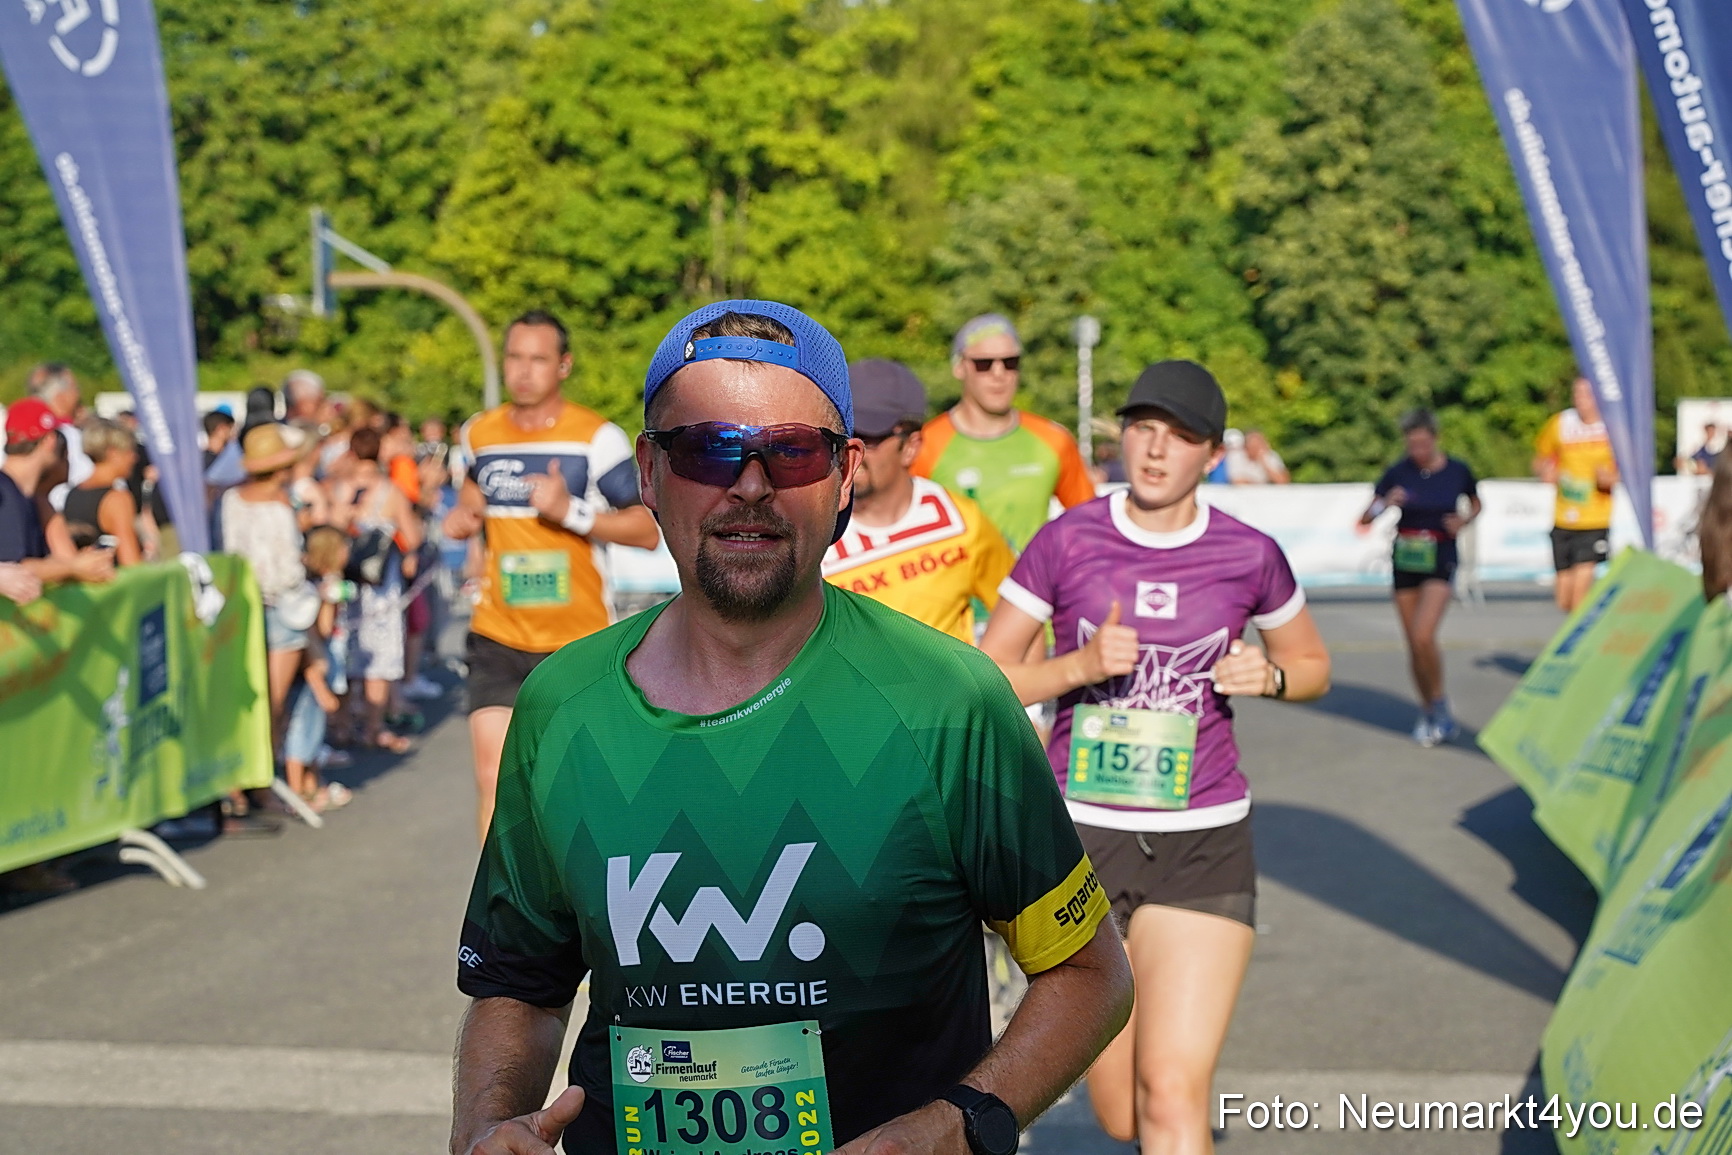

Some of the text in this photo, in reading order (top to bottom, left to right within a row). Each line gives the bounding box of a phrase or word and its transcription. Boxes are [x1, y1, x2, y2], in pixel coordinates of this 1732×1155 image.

[700, 677, 792, 728] #teamkwenergie
[1092, 741, 1174, 775] 1526
[458, 945, 483, 968] GE
[625, 980, 828, 1008] KW ENERGIE
[655, 1060, 717, 1074] Firmenlauf
[679, 1072, 717, 1082] neumarkt
[644, 1086, 790, 1144] 1308
